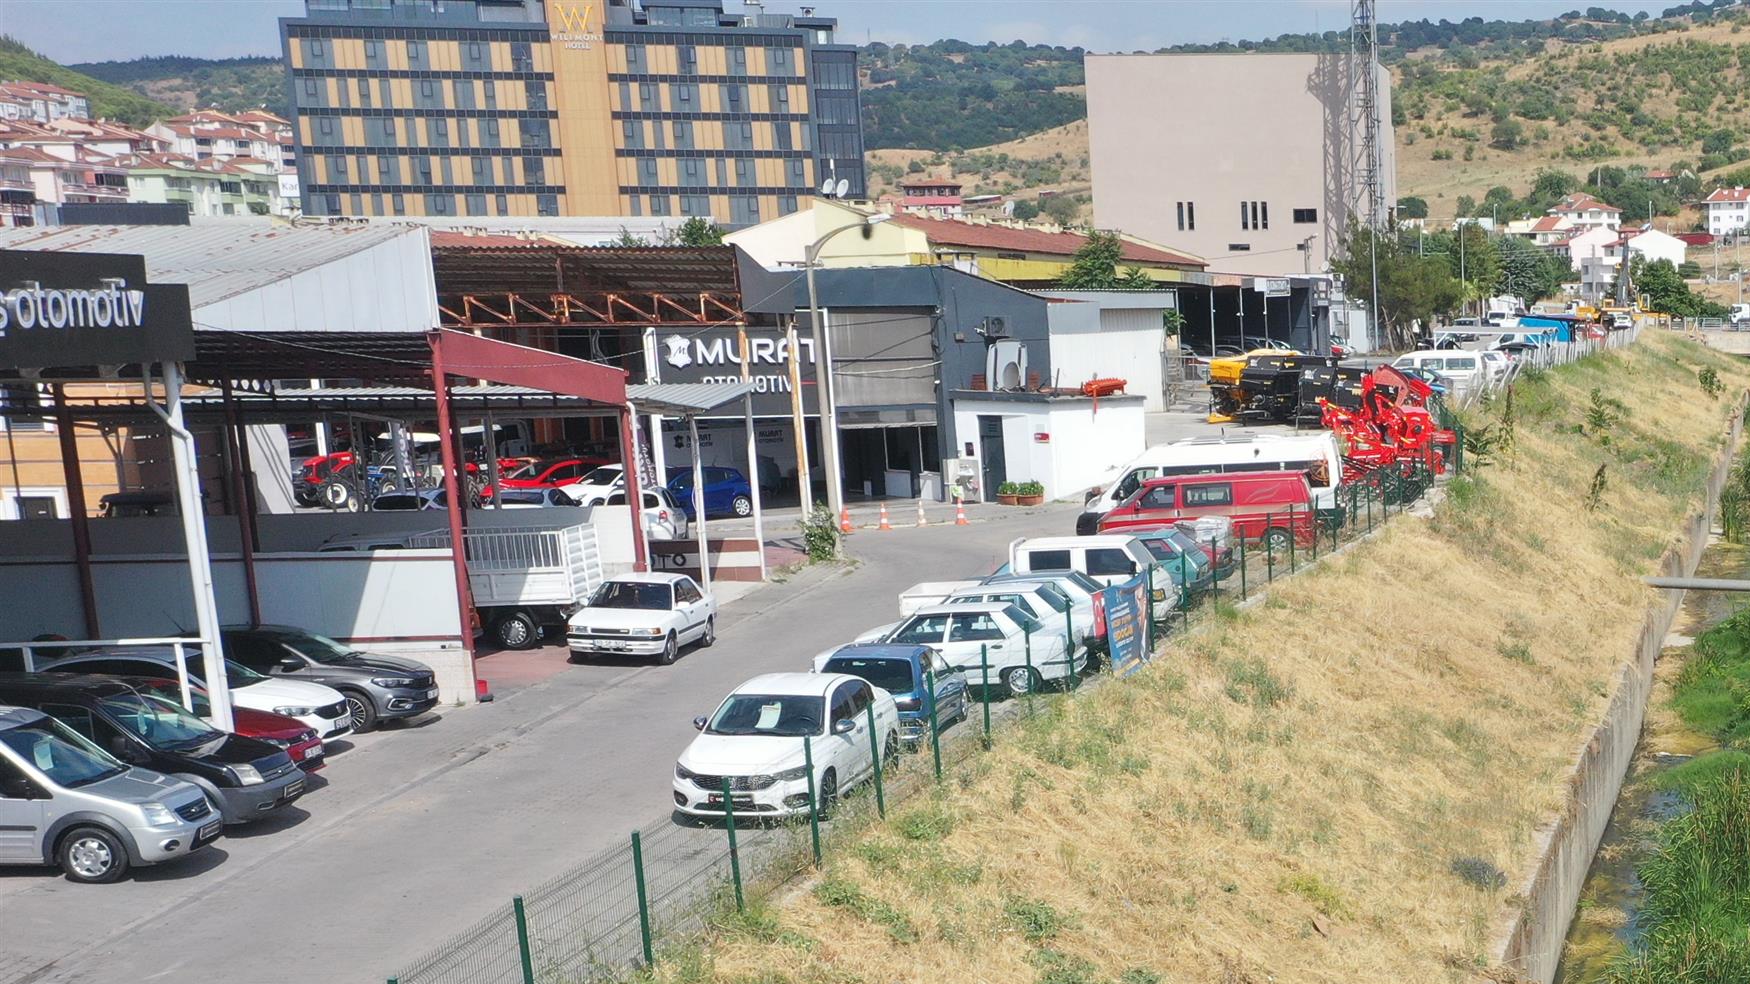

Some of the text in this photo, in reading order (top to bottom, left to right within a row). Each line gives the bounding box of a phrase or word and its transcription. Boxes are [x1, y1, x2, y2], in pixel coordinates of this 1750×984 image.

[554, 3, 592, 32] W
[16, 278, 144, 329] otomotiv
[696, 338, 815, 365] MURAT
